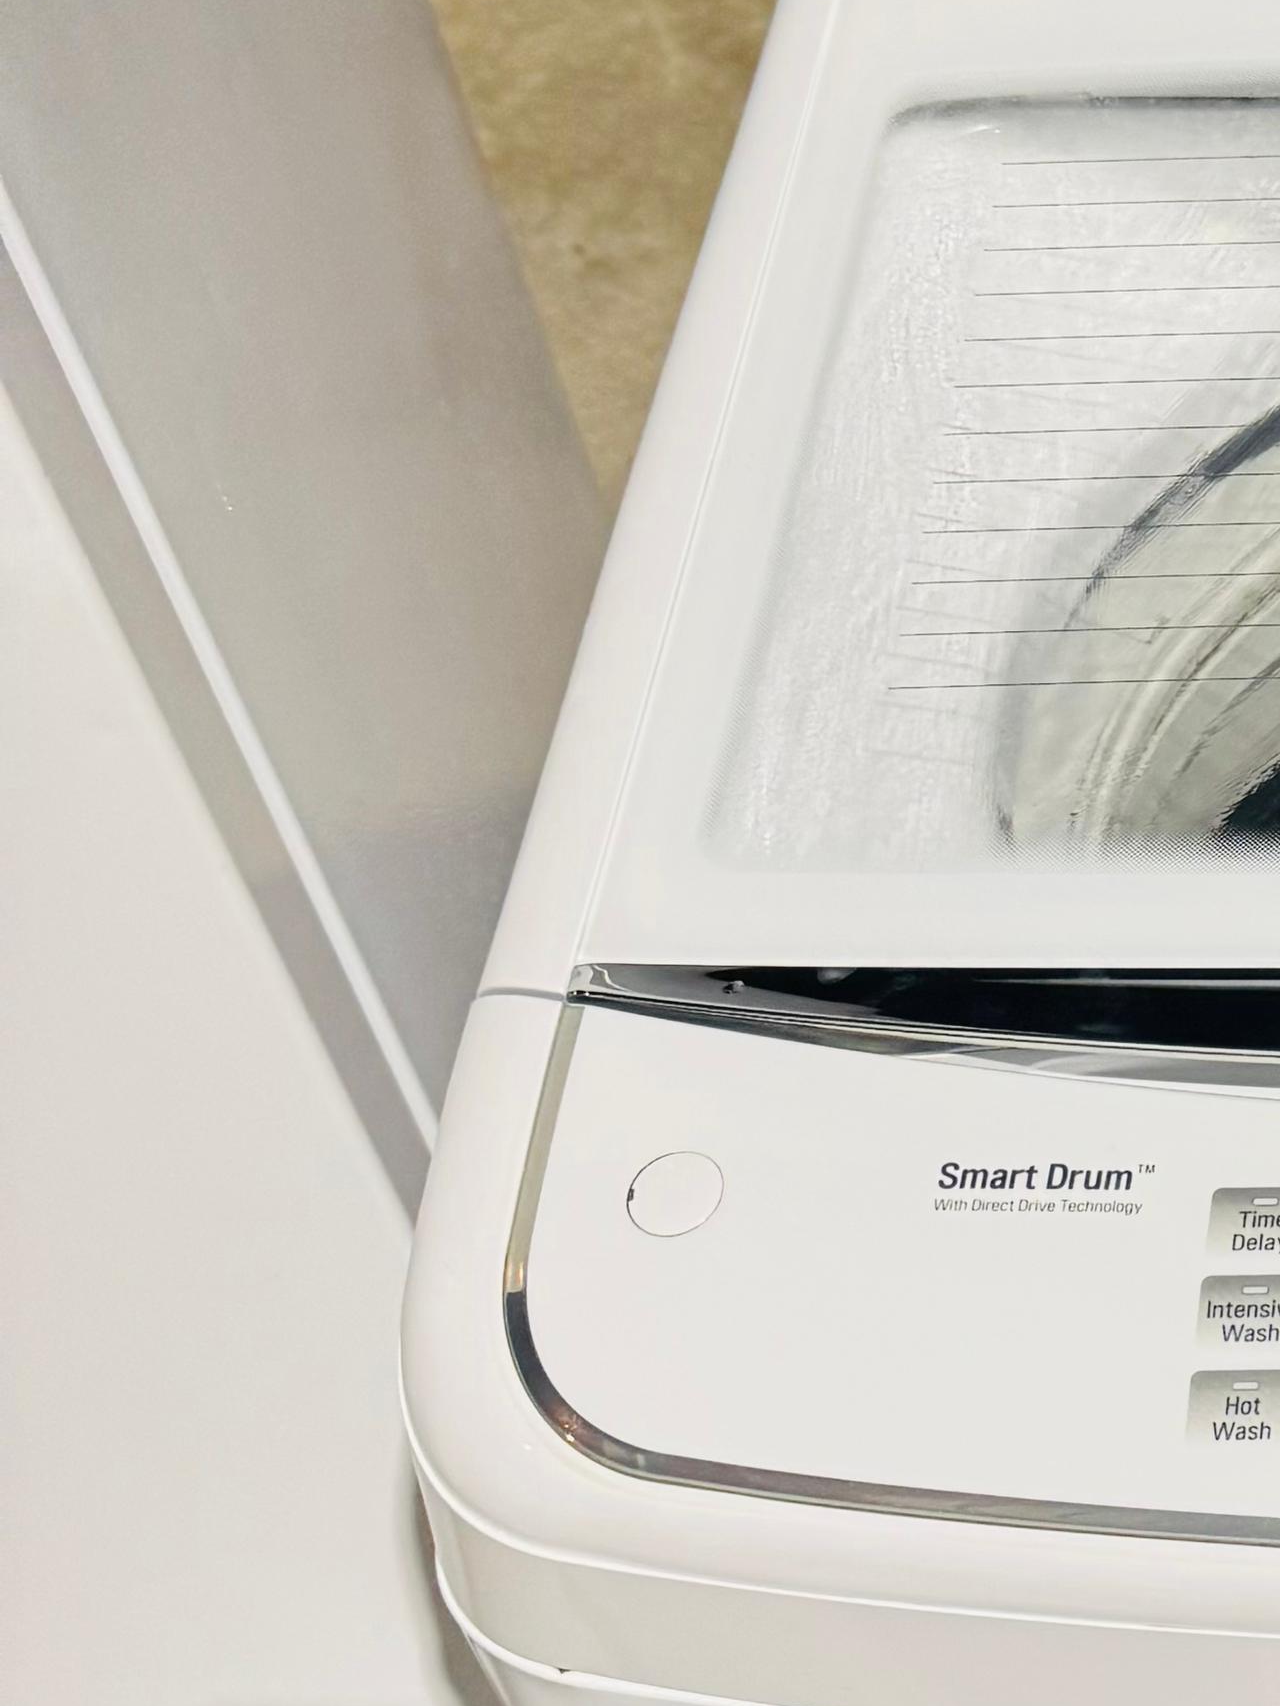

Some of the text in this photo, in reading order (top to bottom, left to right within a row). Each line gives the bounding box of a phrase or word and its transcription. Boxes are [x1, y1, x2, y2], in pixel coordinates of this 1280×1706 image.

[938, 1162, 1038, 1190] Smart
[934, 1198, 1143, 1216] With Direct Drive Technology
[1222, 1324, 1279, 1342] Wash
[1225, 1396, 1261, 1415] Hot
[1213, 1421, 1271, 1440] Wash
